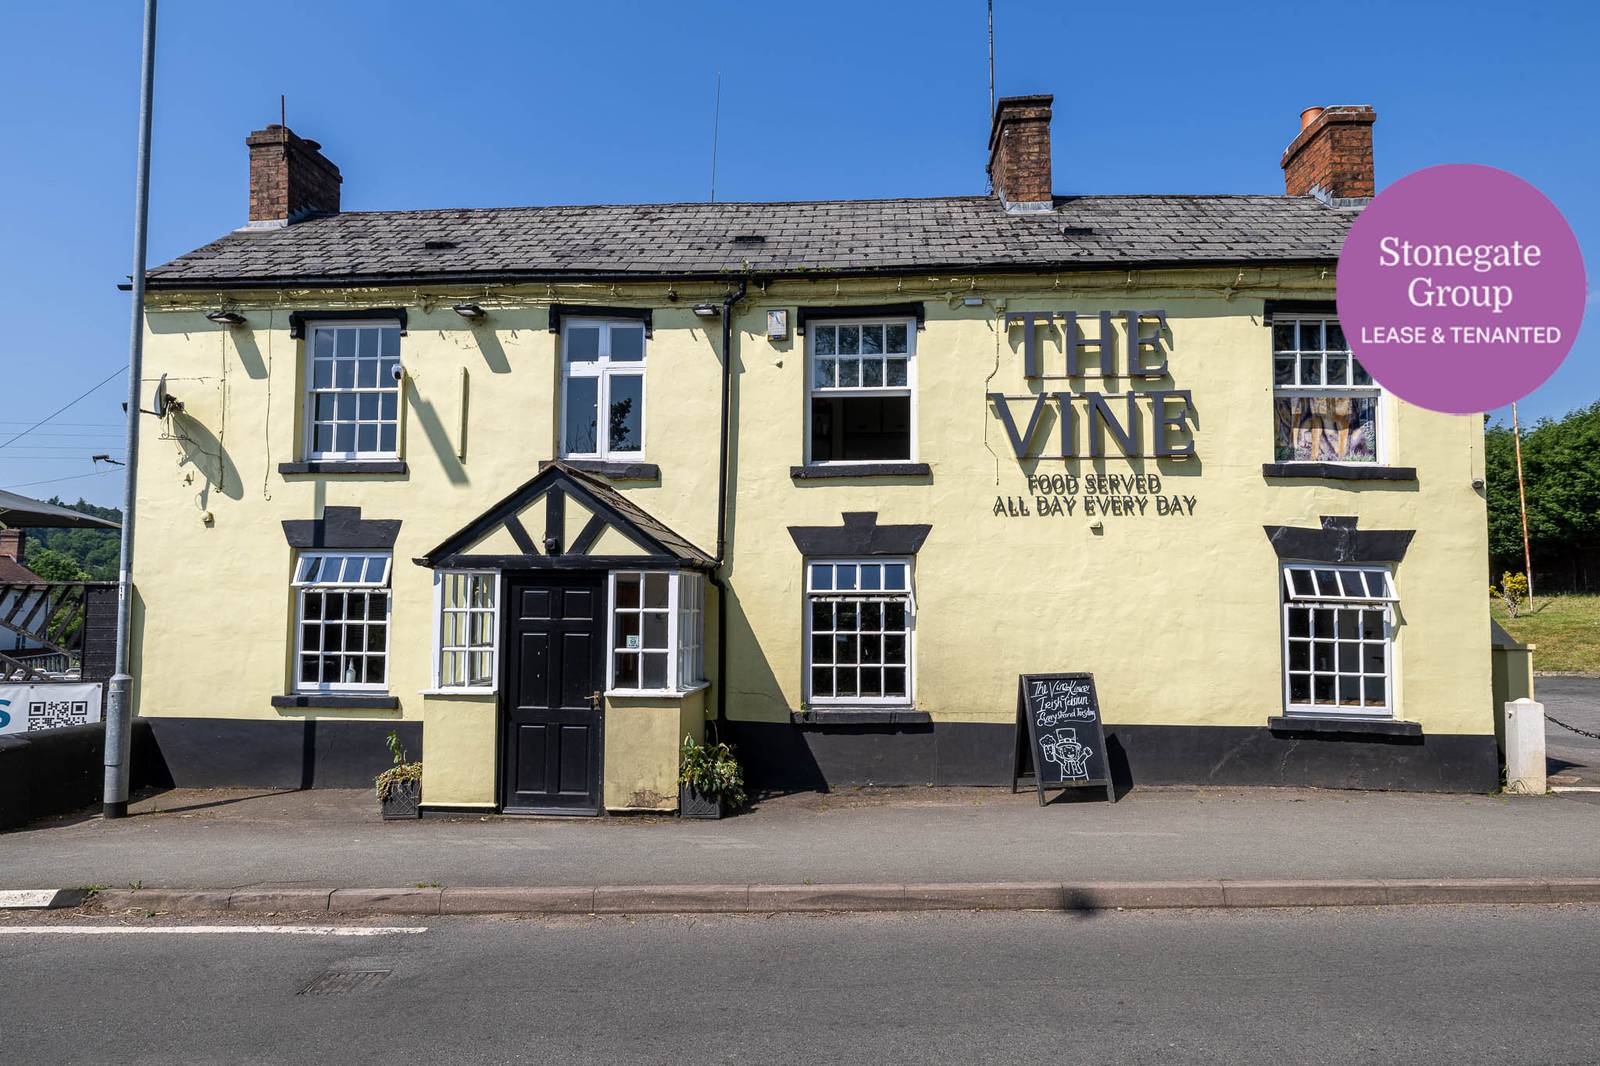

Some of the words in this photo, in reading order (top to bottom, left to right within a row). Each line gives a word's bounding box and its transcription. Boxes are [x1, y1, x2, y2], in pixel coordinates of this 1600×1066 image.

[1004, 310, 1169, 377] THE
[986, 390, 1195, 459] VINE
[1027, 474, 1078, 494] FOOD
[1085, 474, 1161, 494] SERVED
[994, 496, 1030, 516] ALL
[1036, 496, 1076, 516] DAY
[1083, 495, 1148, 516] EVERY
[1156, 495, 1197, 516] DAY
[1031, 681, 1048, 698] The
[1049, 681, 1070, 697] Vine
[1036, 696, 1062, 713] Irish
